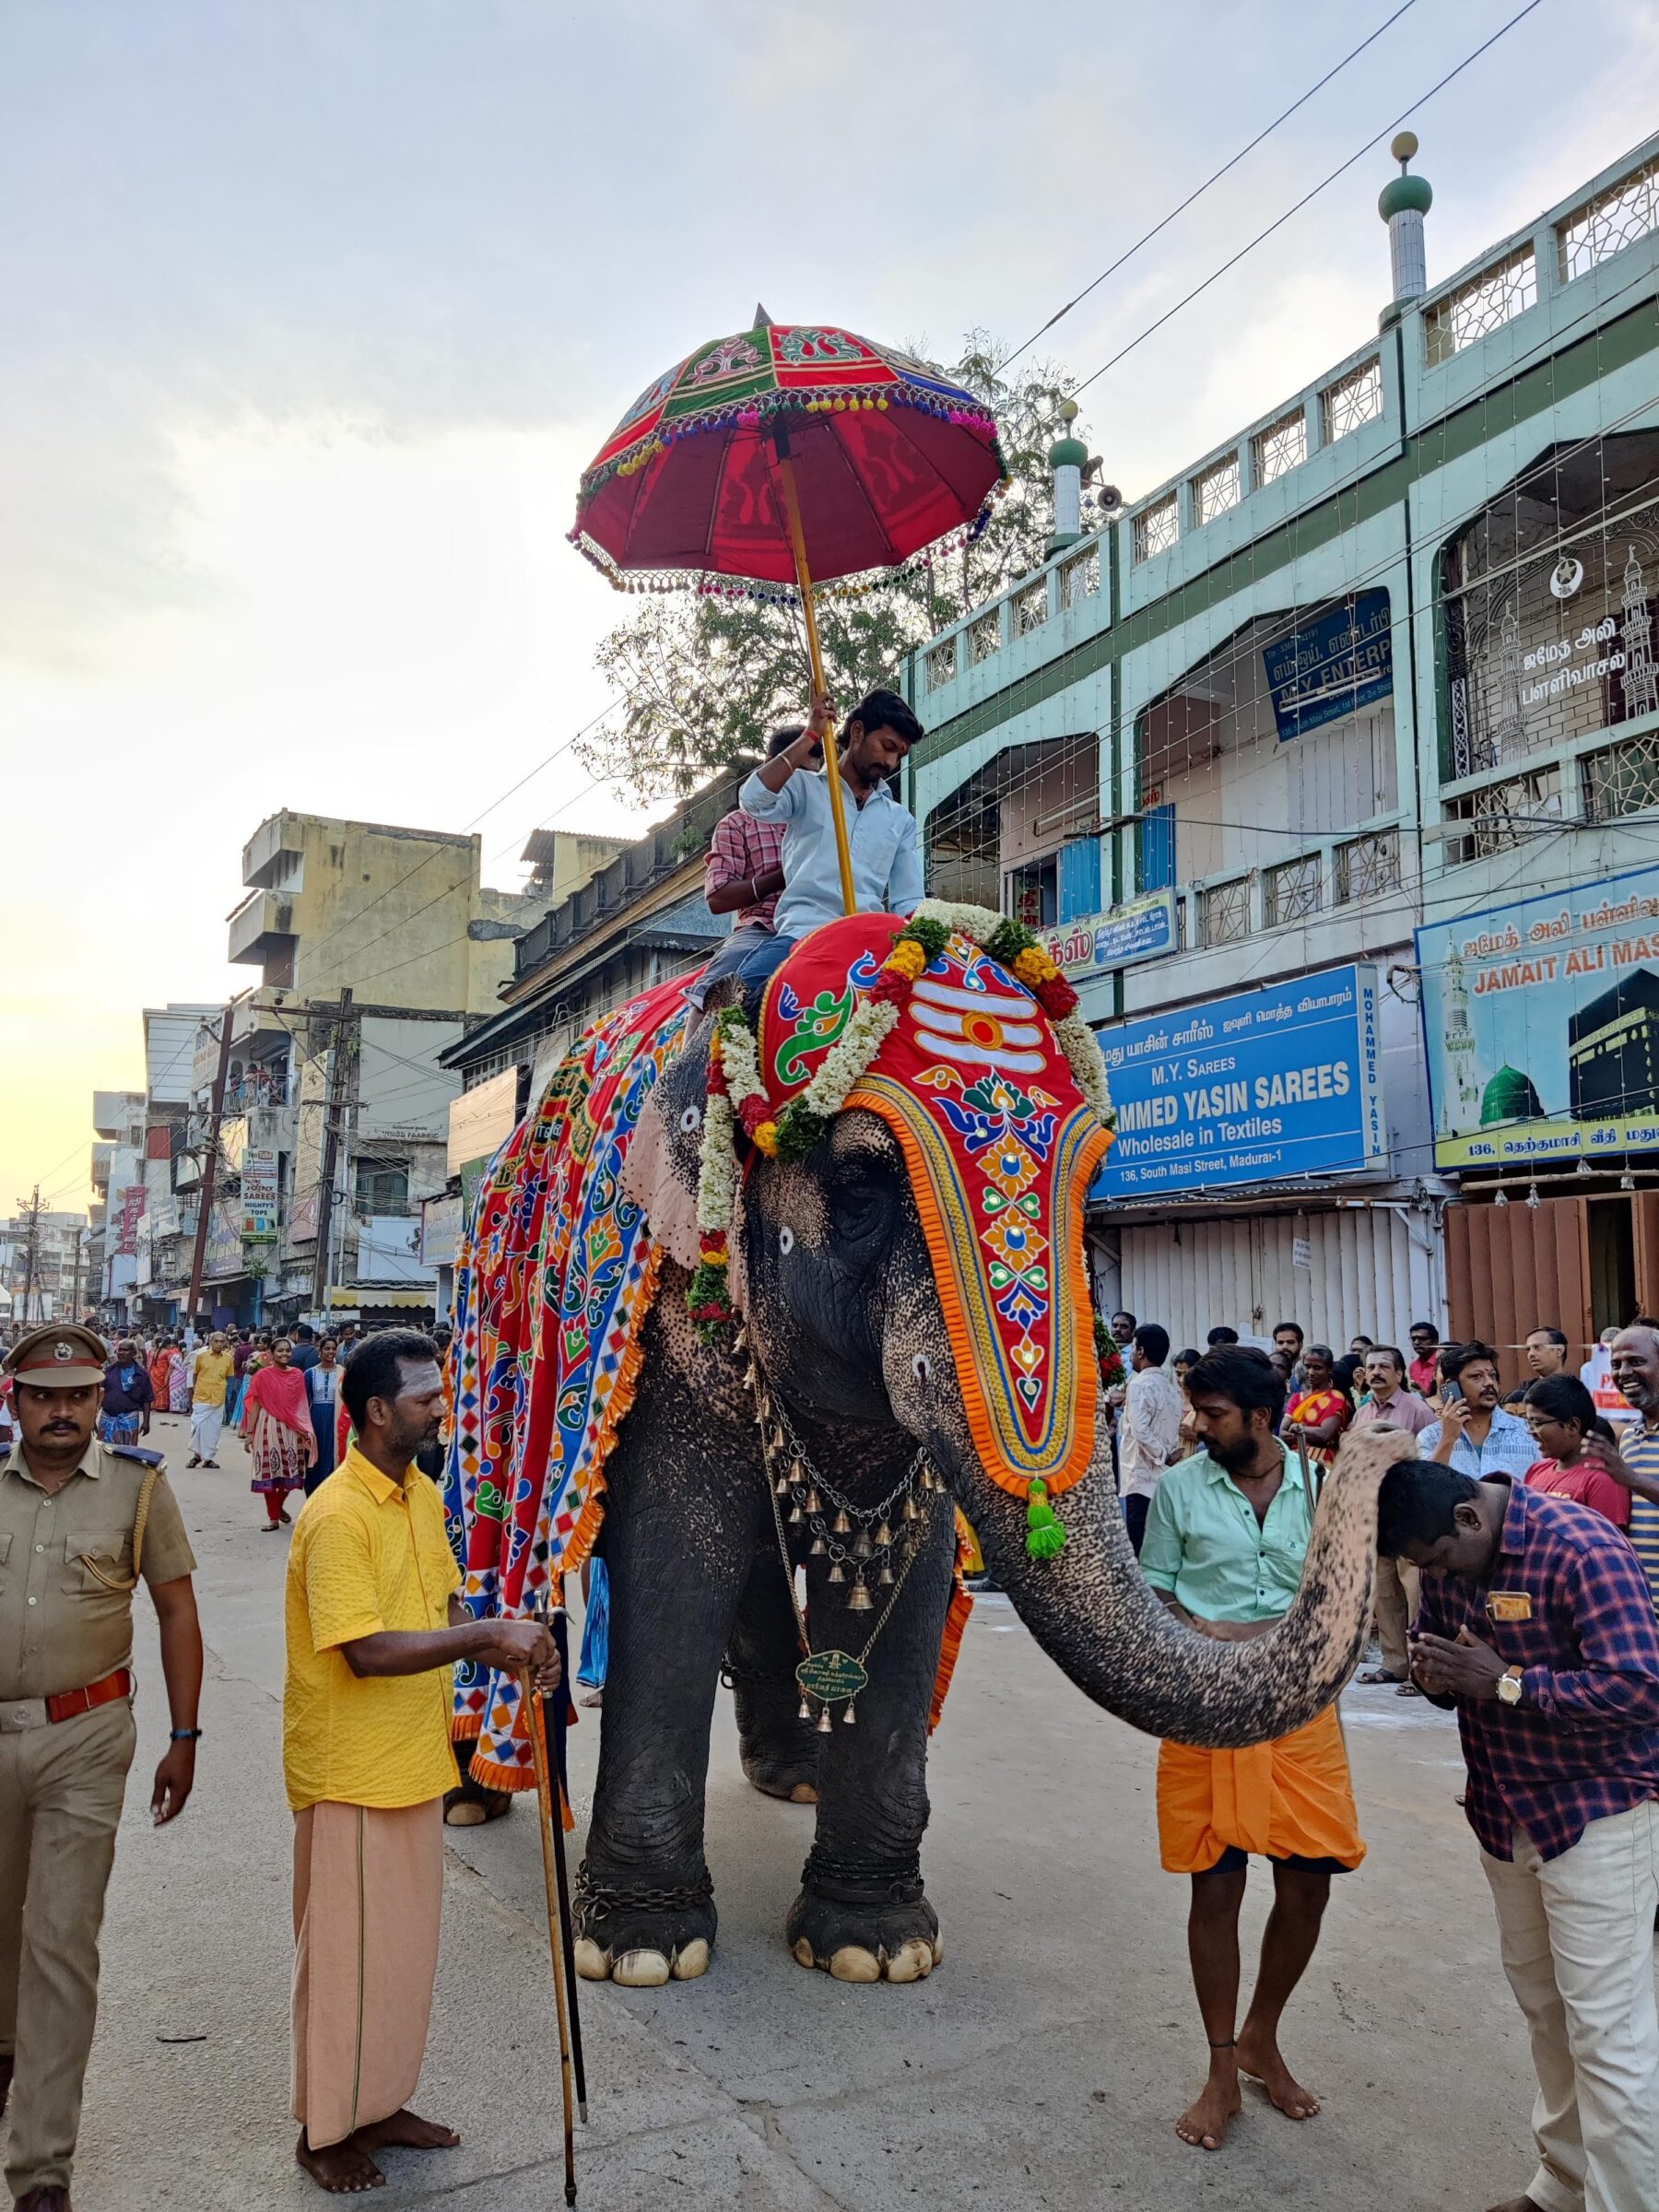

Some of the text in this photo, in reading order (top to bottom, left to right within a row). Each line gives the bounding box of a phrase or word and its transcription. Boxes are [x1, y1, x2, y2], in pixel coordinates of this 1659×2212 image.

[1575, 618, 1616, 649] அலி
[1530, 912, 1571, 941] அலி
[1474, 957, 1558, 994] JAMAIT
[1566, 944, 1605, 975] ALI
[1127, 1029, 1169, 1057] யாசின்
[1172, 1018, 1214, 1046] சாரீஸ்
[1223, 1012, 1252, 1032] ஜவுளி
[1256, 1003, 1292, 1022] மொத்த
[1297, 985, 1352, 1012] வியாபாரம்
[1151, 1062, 1182, 1087] M.Y.
[1363, 987, 1382, 1156] MOHAMMED YASIN
[1182, 1080, 1248, 1121] YASIN
[1254, 1061, 1350, 1110] SAREES
[1117, 1116, 1283, 1158] Wholesale in Textiles
[1503, 1132, 1581, 1155] தெற்குமாசி
[1590, 1128, 1617, 1146] வீதி
[1120, 1170, 1138, 1182] 136,
[1141, 1165, 1167, 1180] South
[1170, 1161, 1192, 1175] Masi
[1194, 1158, 1227, 1172] Street,
